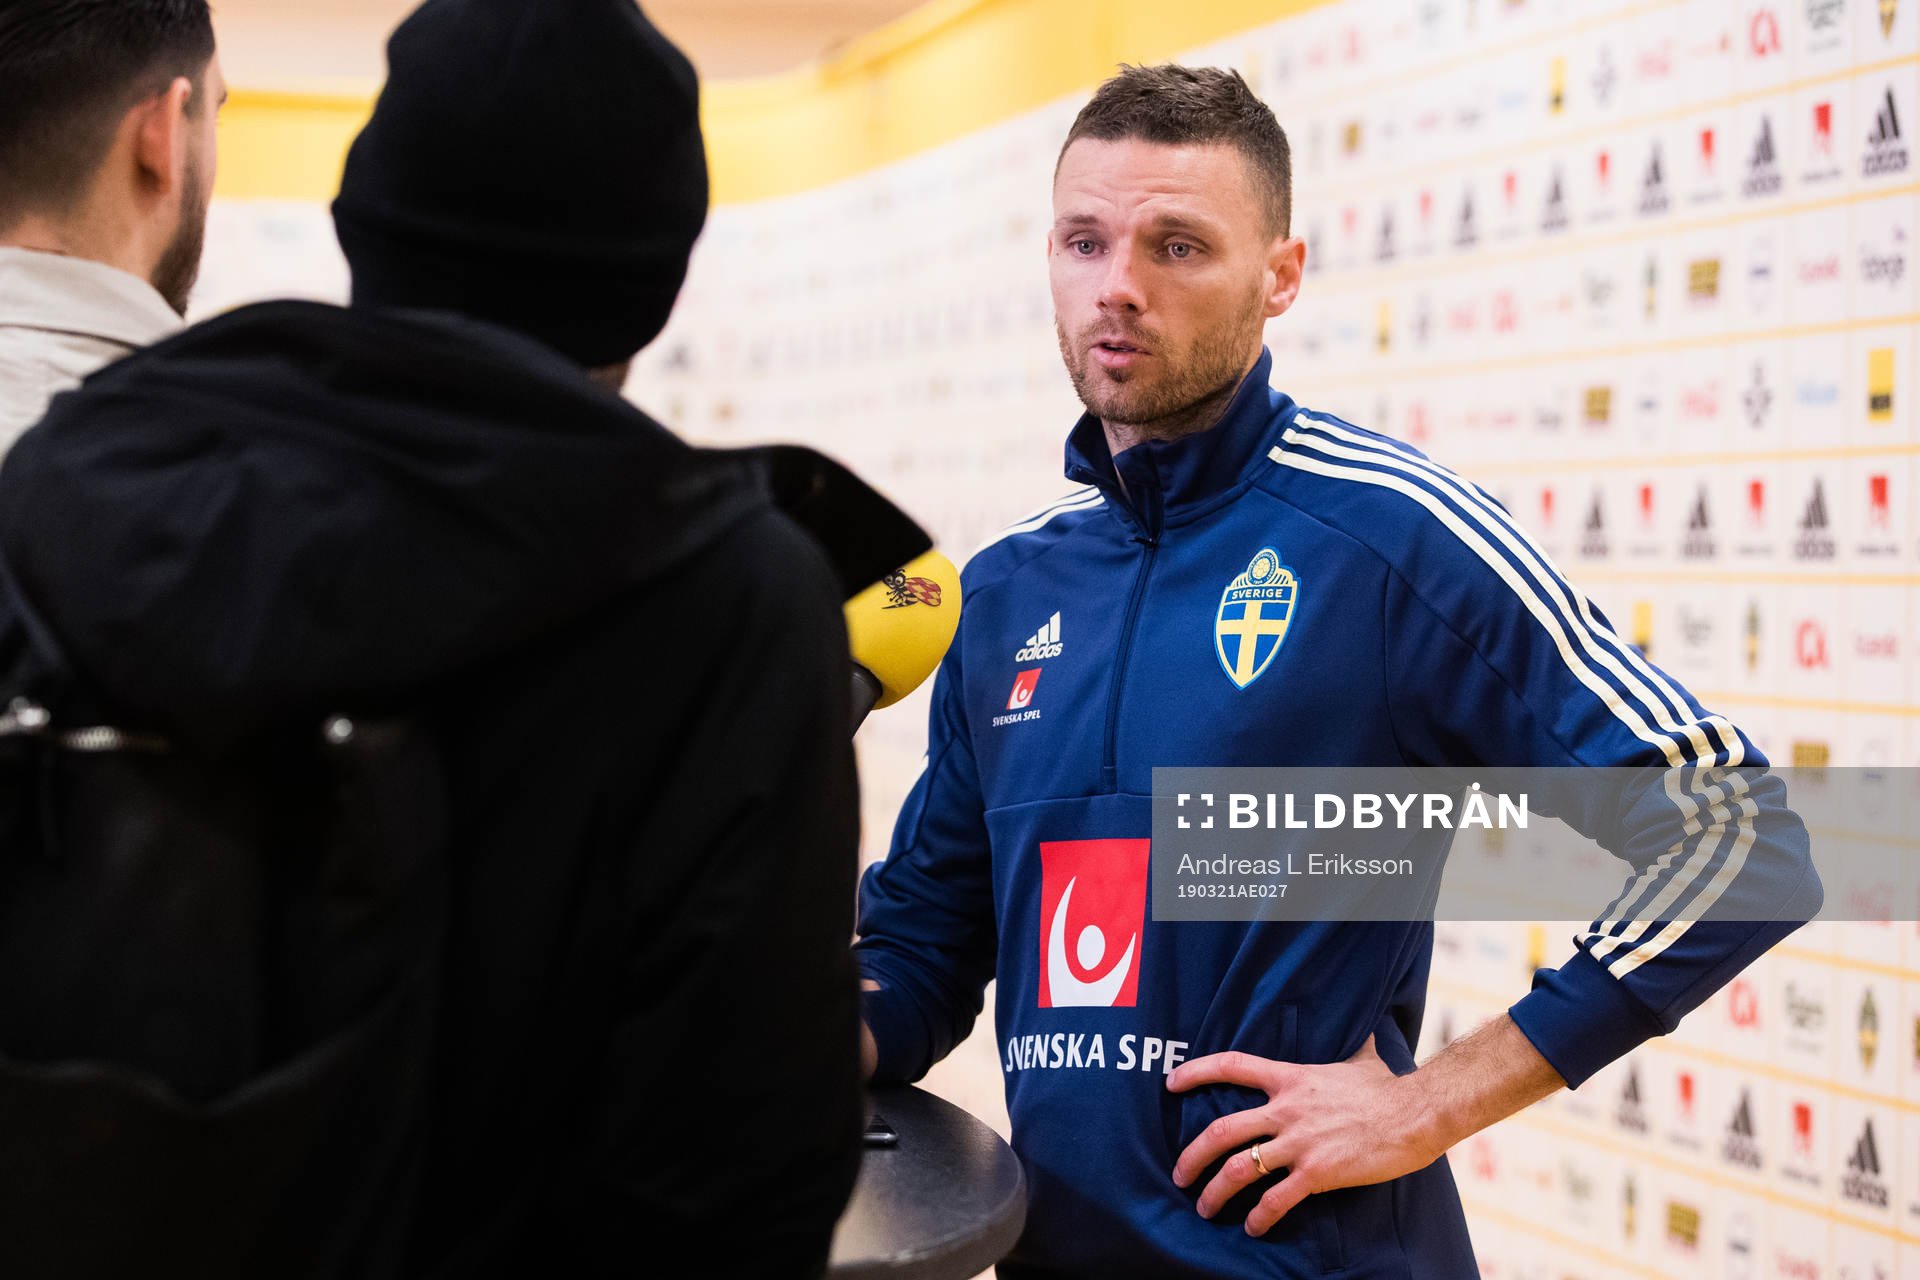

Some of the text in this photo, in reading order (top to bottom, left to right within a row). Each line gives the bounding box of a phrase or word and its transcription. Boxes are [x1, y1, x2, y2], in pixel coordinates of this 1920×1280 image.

[1231, 588, 1283, 600] SVERIGE
[1015, 641, 1064, 663] adidas
[992, 709, 1041, 727] SVENSKA SPEL
[1005, 1033, 1189, 1075] SVENSKA SPE
